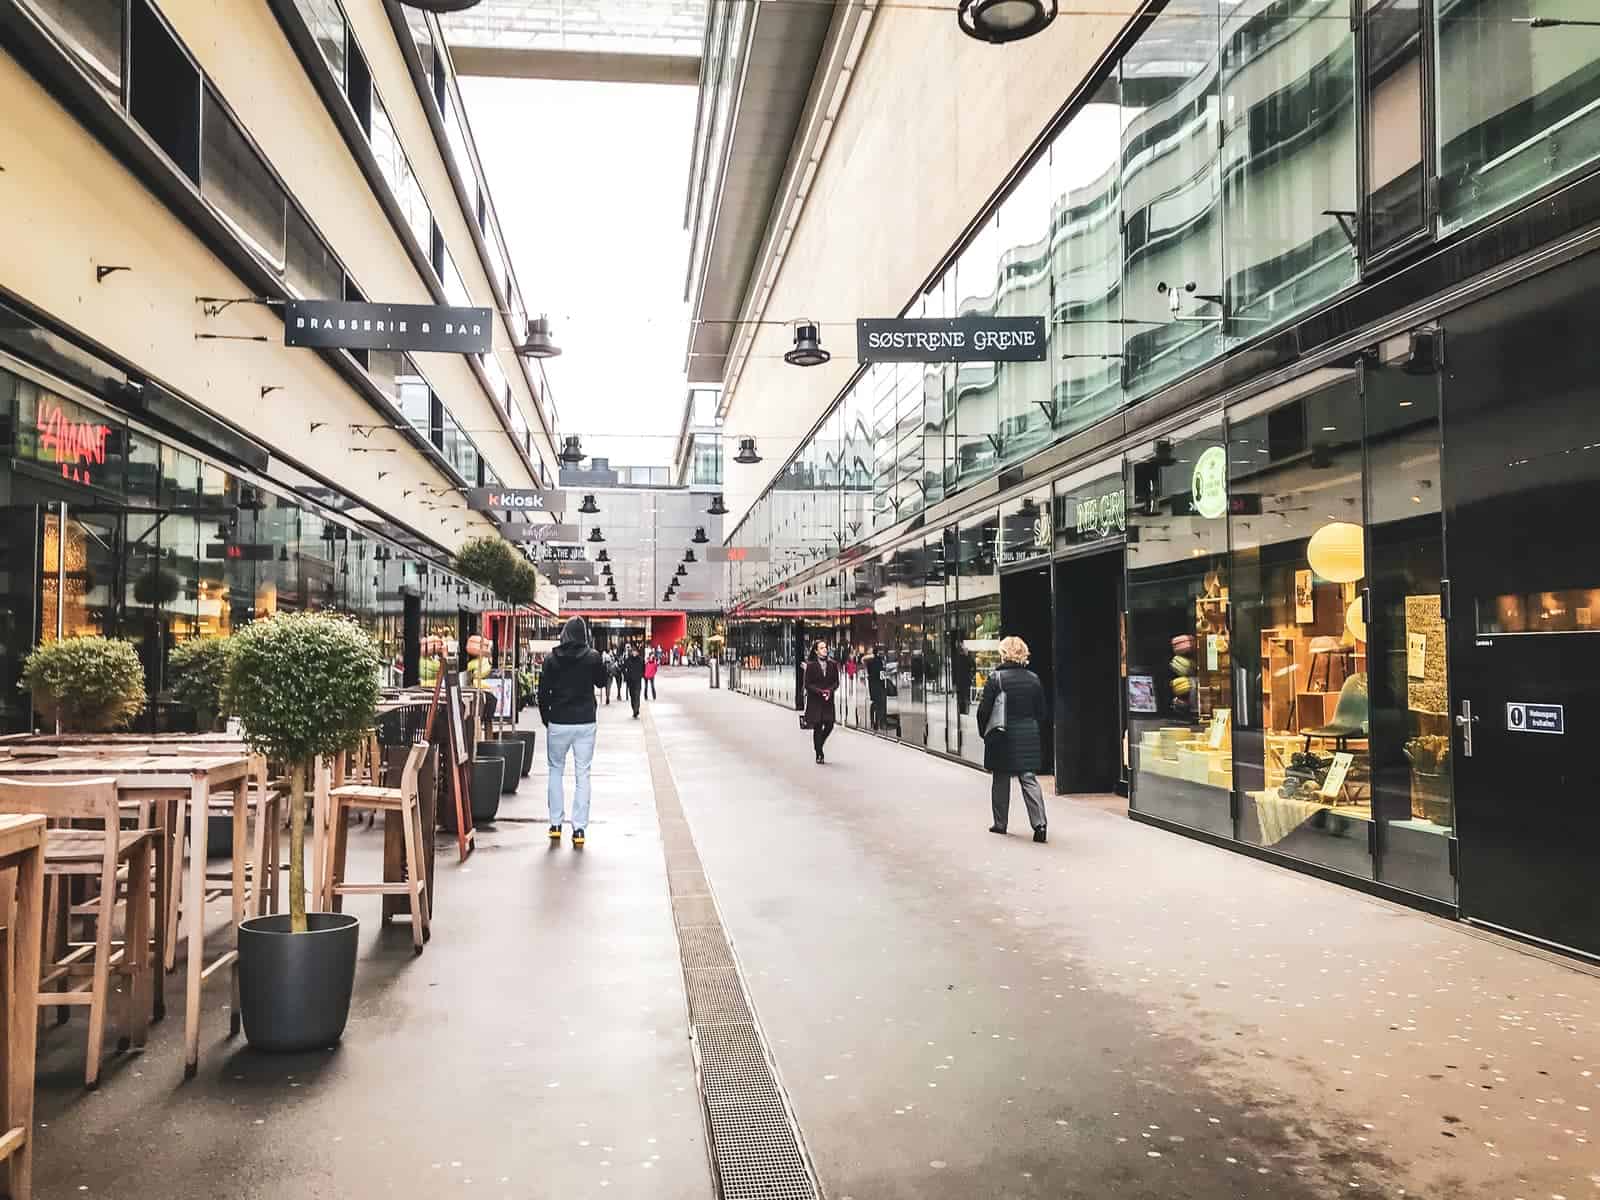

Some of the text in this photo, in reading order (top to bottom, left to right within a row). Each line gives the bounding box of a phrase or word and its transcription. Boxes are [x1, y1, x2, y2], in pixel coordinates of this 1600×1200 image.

[296, 317, 482, 336] BRASSERIE & BAR
[868, 330, 1037, 352] SØSTRENE GRENE
[501, 492, 544, 508] kiosk
